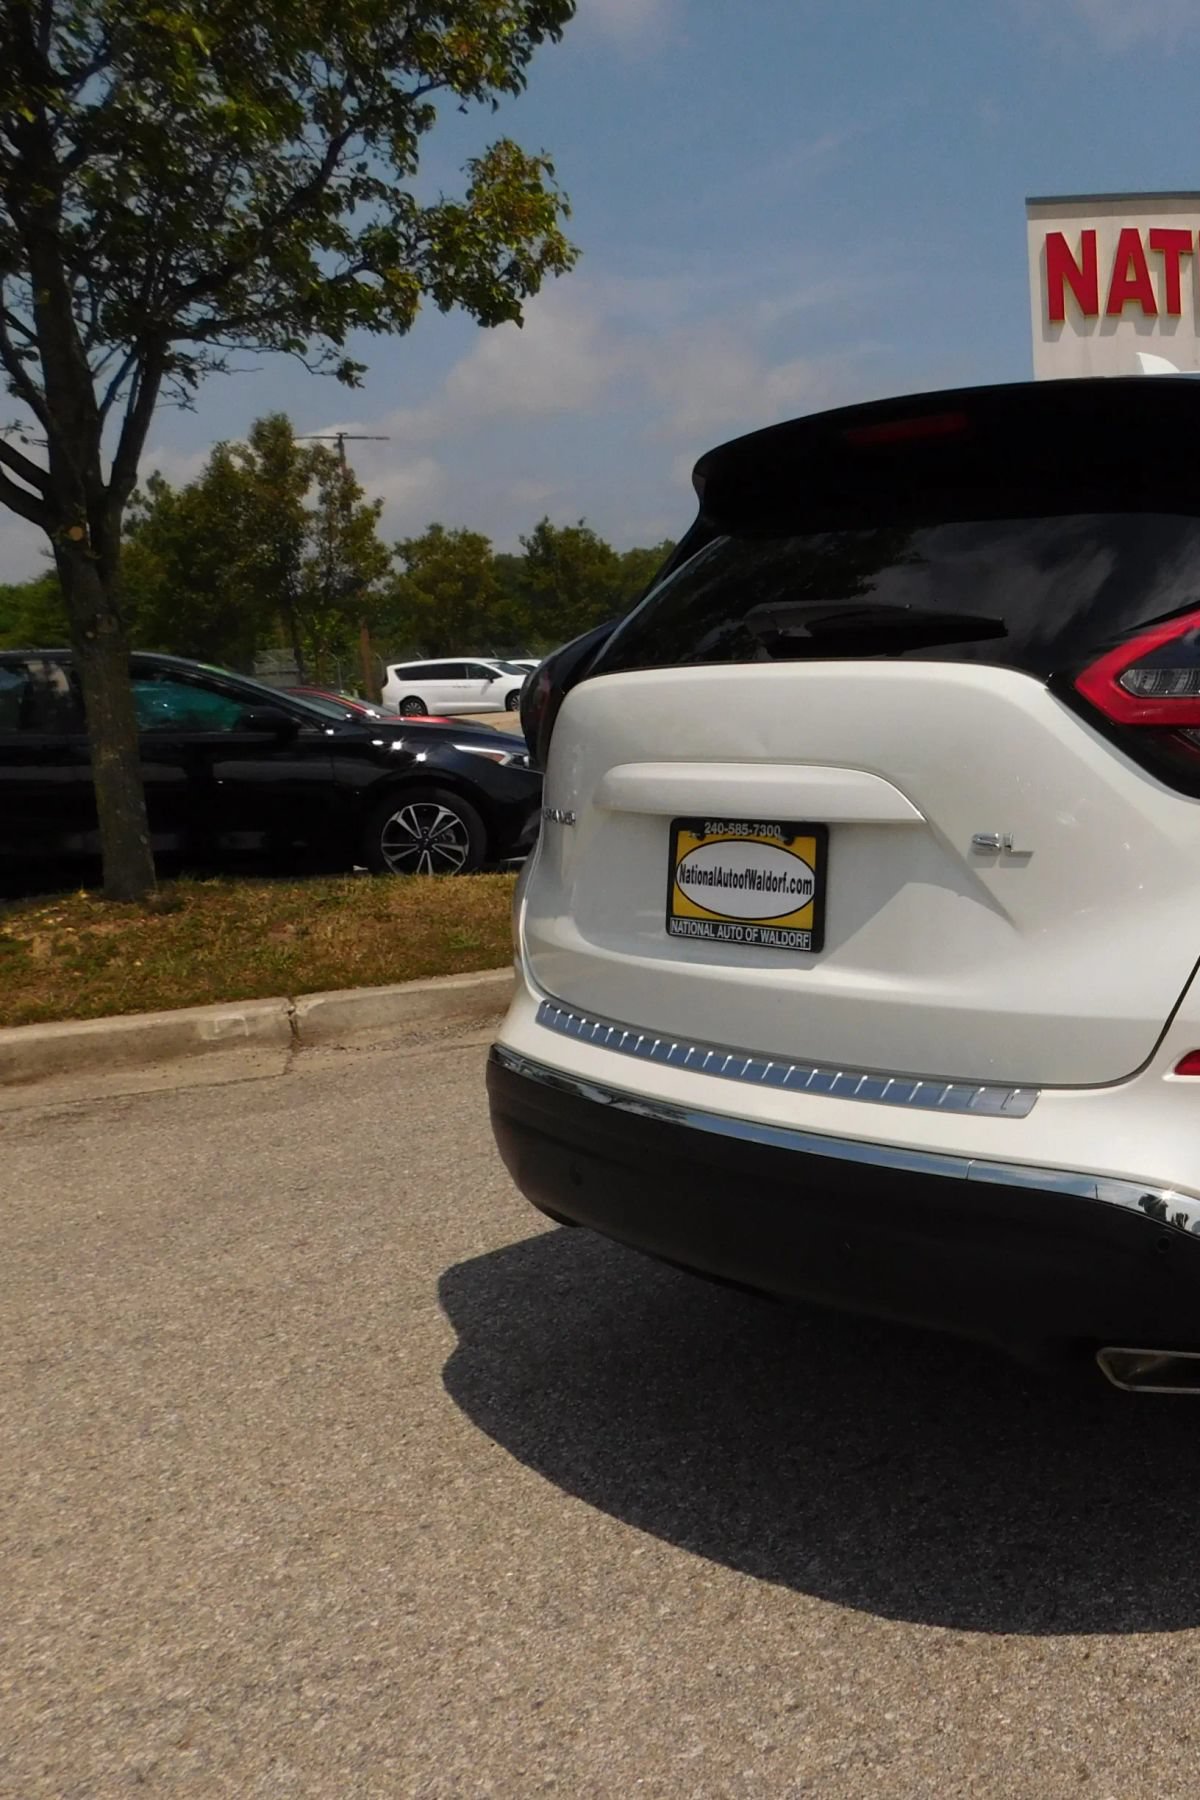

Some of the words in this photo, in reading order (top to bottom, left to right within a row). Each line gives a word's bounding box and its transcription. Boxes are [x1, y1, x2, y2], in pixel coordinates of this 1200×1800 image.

[704, 822, 782, 838] 240-585-7300
[679, 863, 813, 896] NationalAutoofWaldorf.com
[671, 920, 715, 938] NATIONAL
[717, 926, 743, 940] AUTO
[745, 929, 759, 942] OF
[760, 930, 809, 948] WALDORF
